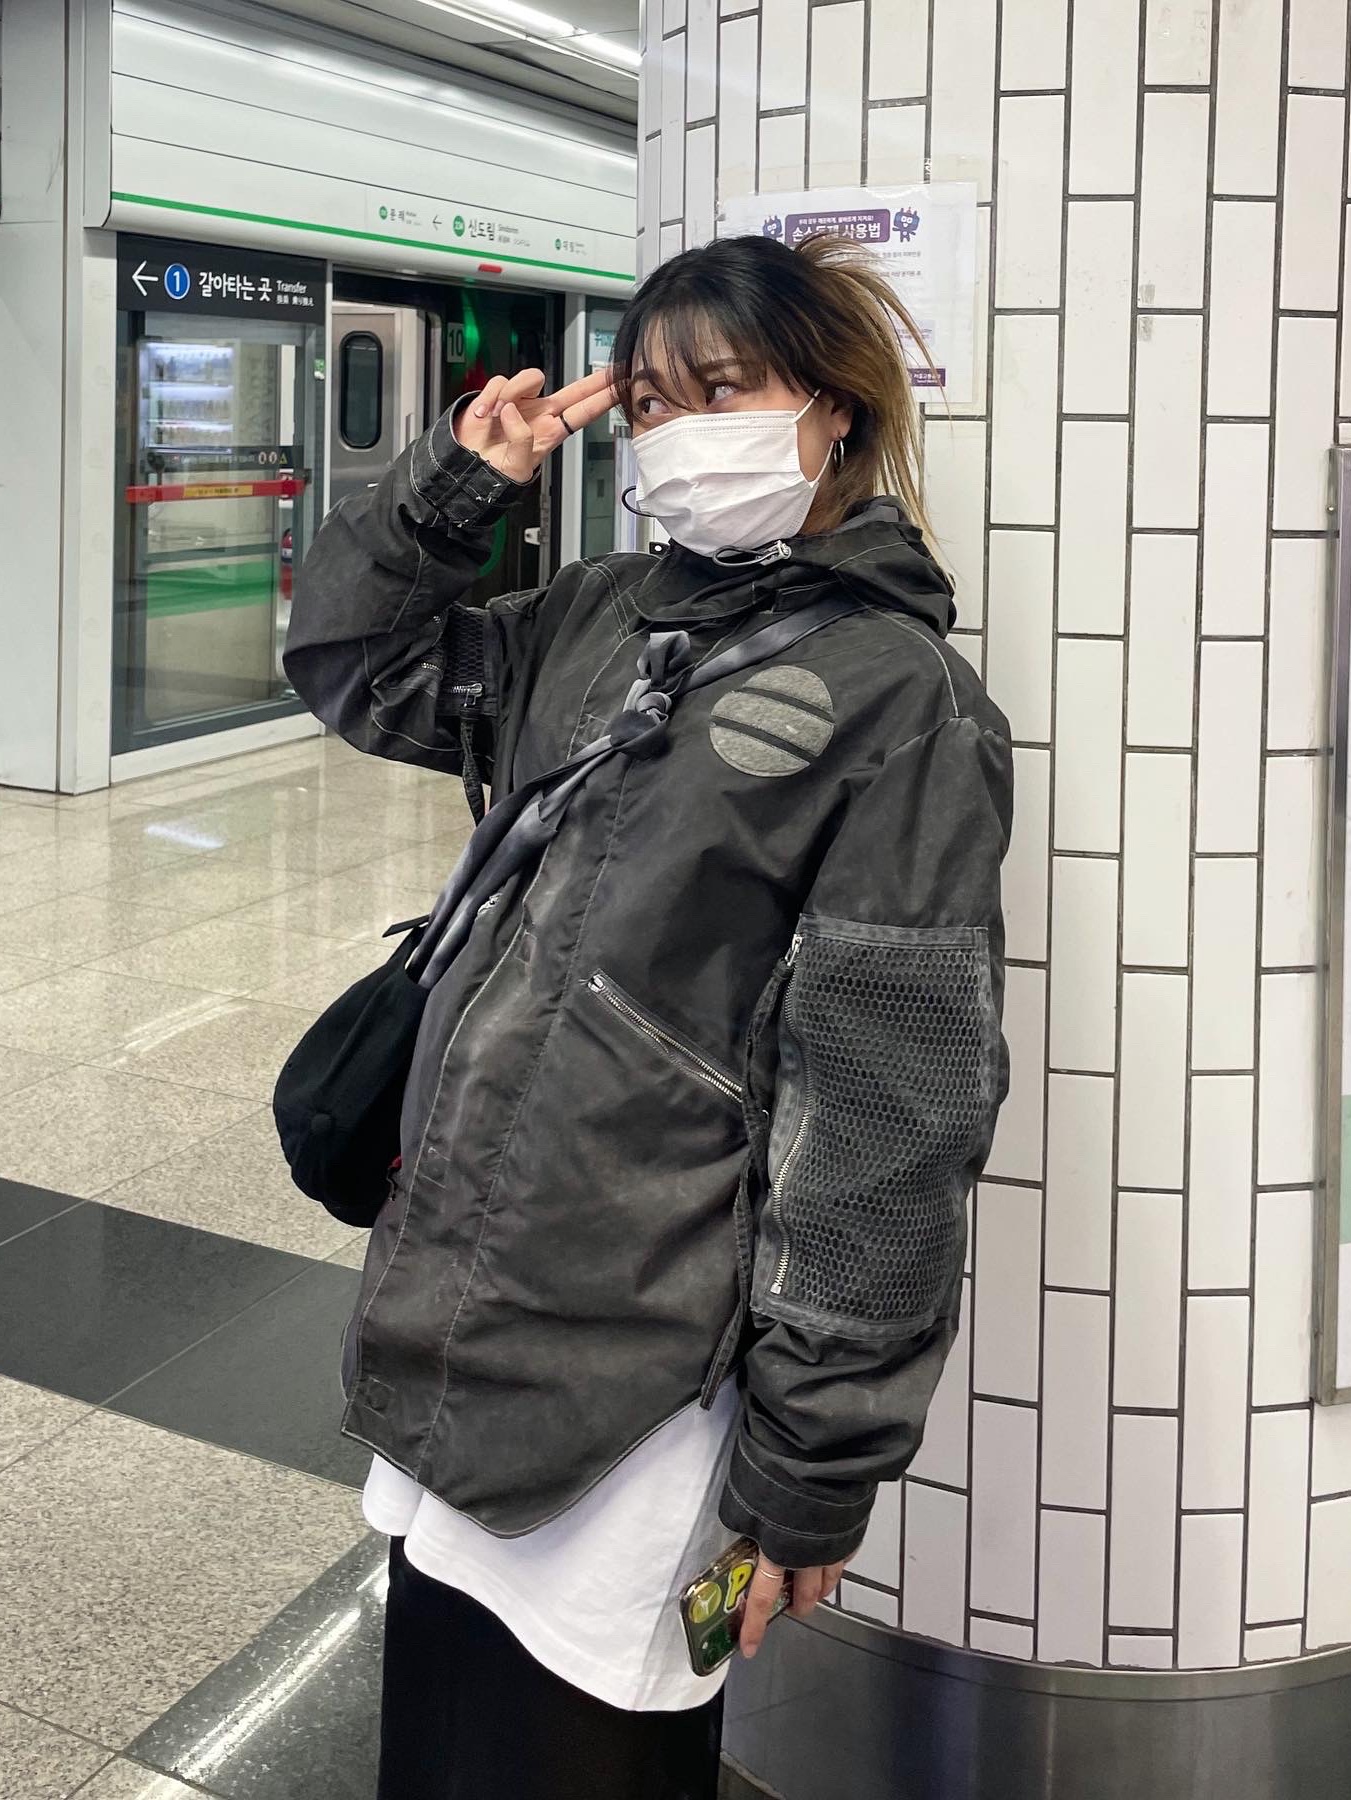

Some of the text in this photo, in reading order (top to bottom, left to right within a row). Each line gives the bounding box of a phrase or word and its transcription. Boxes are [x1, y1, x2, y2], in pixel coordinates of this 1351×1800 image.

[468, 219, 495, 240] 신도림
[842, 223, 881, 239] 사용법
[173, 271, 180, 292] 1
[199, 272, 273, 301] 갈아타는 곳
[276, 280, 307, 294] Transfer
[449, 329, 464, 357] 10
